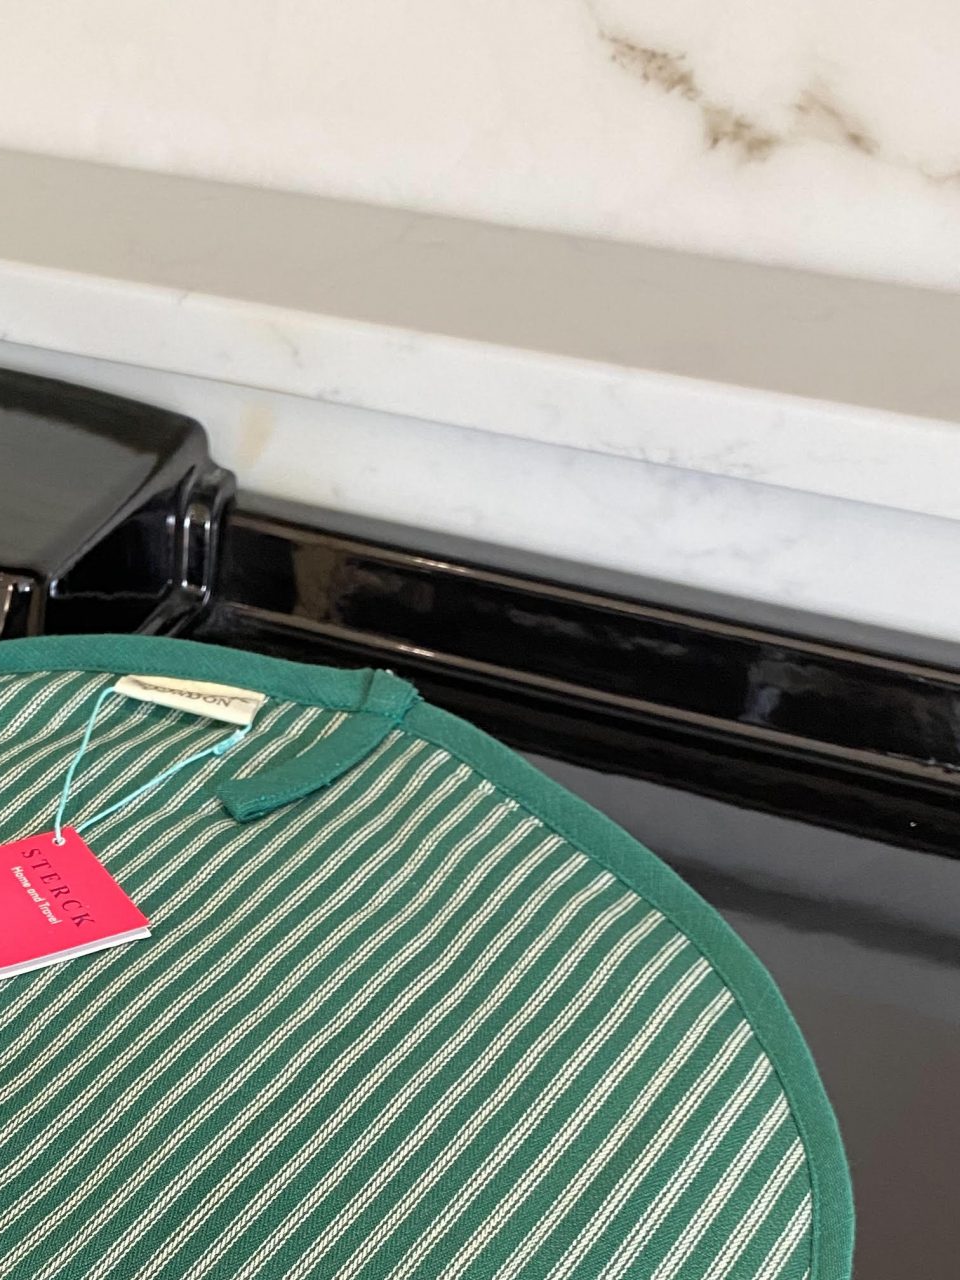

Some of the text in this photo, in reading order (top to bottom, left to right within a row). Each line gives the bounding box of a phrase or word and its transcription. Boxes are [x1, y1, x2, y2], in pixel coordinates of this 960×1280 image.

[11, 866, 62, 925] Home and Travel
[22, 848, 95, 927] STERCK
